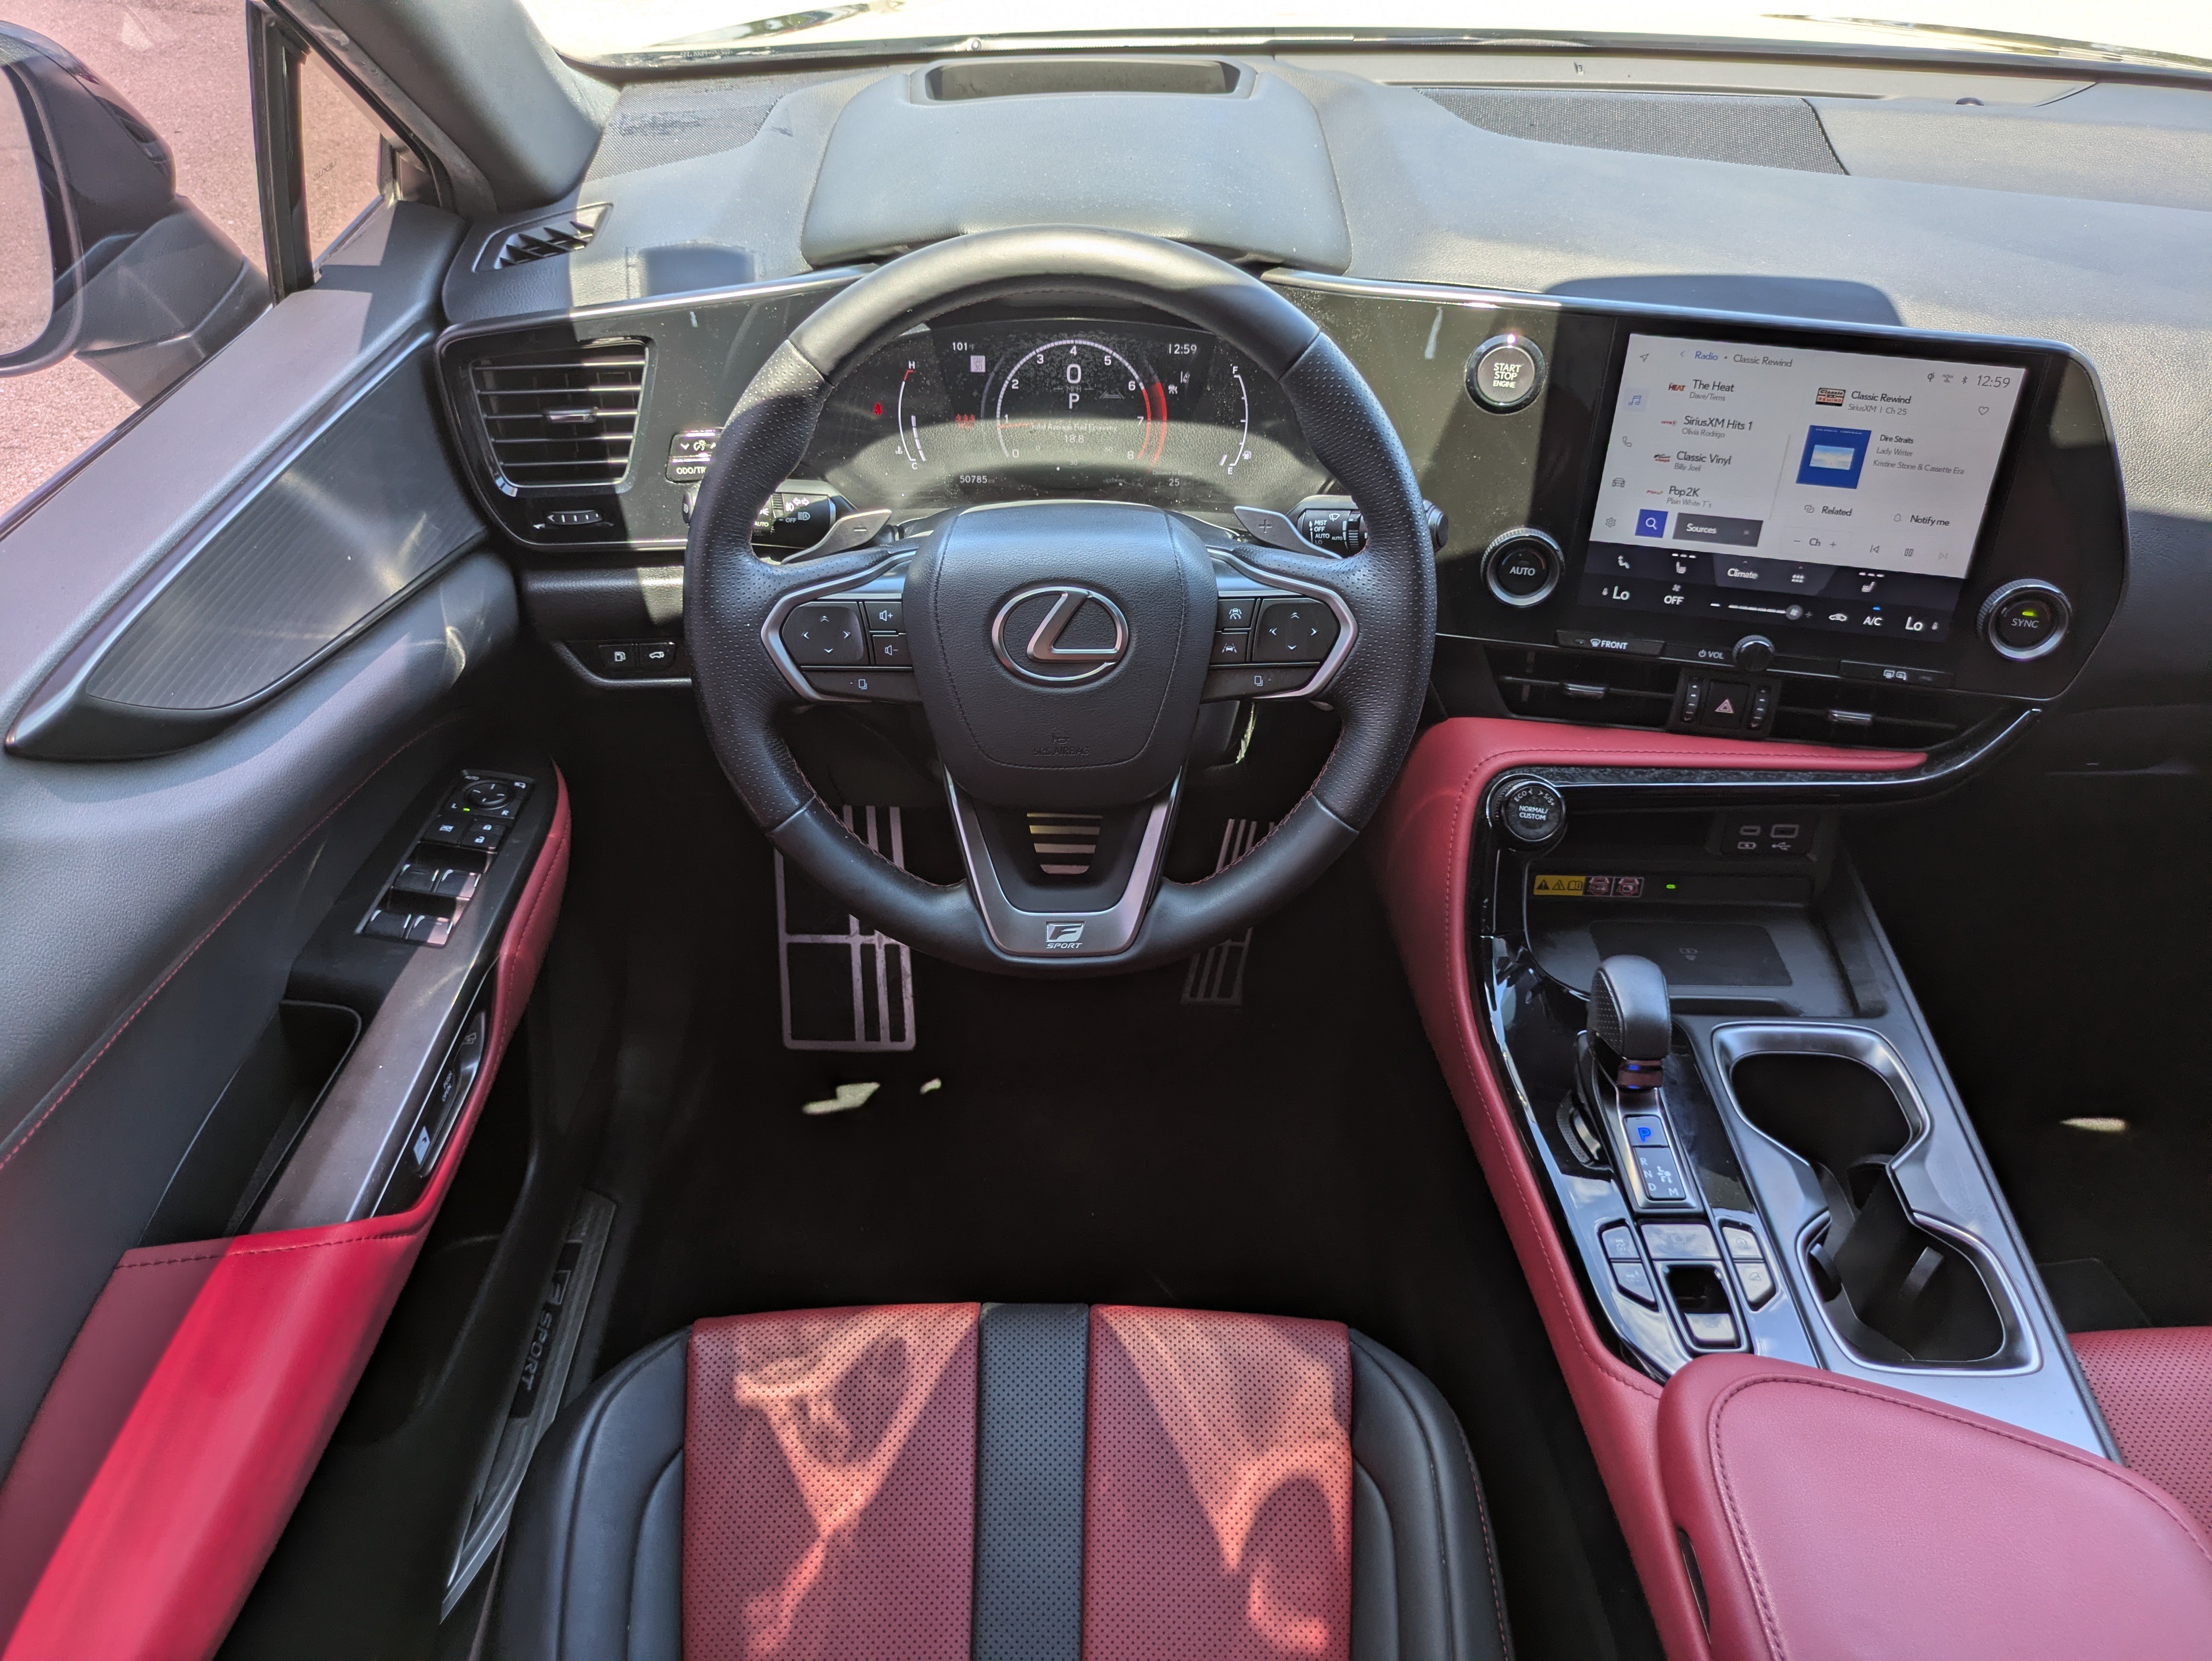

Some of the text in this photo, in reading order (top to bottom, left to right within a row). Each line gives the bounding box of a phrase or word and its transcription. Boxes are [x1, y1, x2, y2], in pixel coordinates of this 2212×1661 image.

[952, 342, 967, 351] 101
[1070, 345, 1077, 356] 4
[1168, 343, 1197, 354] 12:59
[1036, 354, 1044, 364] 3
[1104, 355, 1111, 365] 5
[1694, 351, 1793, 367] Radio Classic Rewind
[908, 360, 916, 369] H
[1232, 365, 1239, 374] F
[1493, 363, 1522, 373] START
[1066, 364, 1082, 384] 0
[1494, 371, 1517, 381] STOP
[1011, 379, 1019, 389] 2
[1128, 381, 1136, 391] 6
[1493, 380, 1516, 388] ENGINE
[1693, 379, 1735, 392] The Heat
[1977, 375, 2010, 388] 12:59
[1069, 393, 1079, 409] P
[1851, 391, 1912, 404] Classic Rewind
[1847, 403, 1877, 412] SiriusXM
[1896, 407, 1907, 415] 25
[1005, 414, 1008, 424] 1
[1137, 416, 1144, 425] 7
[1683, 415, 1725, 428] SiriusXM
[1726, 419, 1745, 431] Hits
[1747, 421, 1753, 431] 1
[1700, 429, 1725, 439] Rodrigo
[1880, 434, 1914, 444] Dire Straits
[1012, 449, 1019, 458] 0
[1127, 450, 1134, 459] 8
[1876, 447, 1913, 457] Lady Writer
[1676, 451, 1707, 463] Classic
[1709, 454, 1732, 466] Vinyl
[676, 466, 707, 475] ODO/TR
[1228, 466, 1233, 475] E
[1872, 459, 1896, 468] Kristine
[1897, 462, 1916, 470] Stone
[1924, 464, 1952, 473] Cassette
[1953, 467, 1965, 475] Era
[959, 475, 987, 484] 50785
[1169, 478, 1180, 486] 25
[1668, 486, 1700, 498] Pop2K
[1821, 506, 1853, 516] Related
[1910, 515, 1936, 526] Notify
[1686, 523, 1717, 534] Sources
[1809, 538, 1821, 546] Ch
[1509, 565, 1536, 576] AUTO
[1727, 568, 1759, 579] Climate
[1613, 586, 1630, 600] Lo
[1664, 595, 1684, 605] OFF
[1863, 616, 1883, 626] A/C
[1905, 617, 1924, 631] Lo
[2011, 618, 2039, 629] SYNC
[1601, 640, 1628, 650] FRONT
[1708, 651, 1724, 659] VOL
[1033, 747, 1090, 756] SRS AIRBAG
[1514, 790, 1527, 802] ECO
[1519, 805, 1548, 814] NORMAL/
[1519, 812, 1547, 821] CUSTOM
[1637, 1127, 1651, 1142] P
[1639, 1157, 1648, 1165] R
[1643, 1169, 1653, 1178] N
[1647, 1182, 1657, 1191] D
[1668, 1187, 1680, 1196] M
[521, 1312, 553, 1392] SPORT
